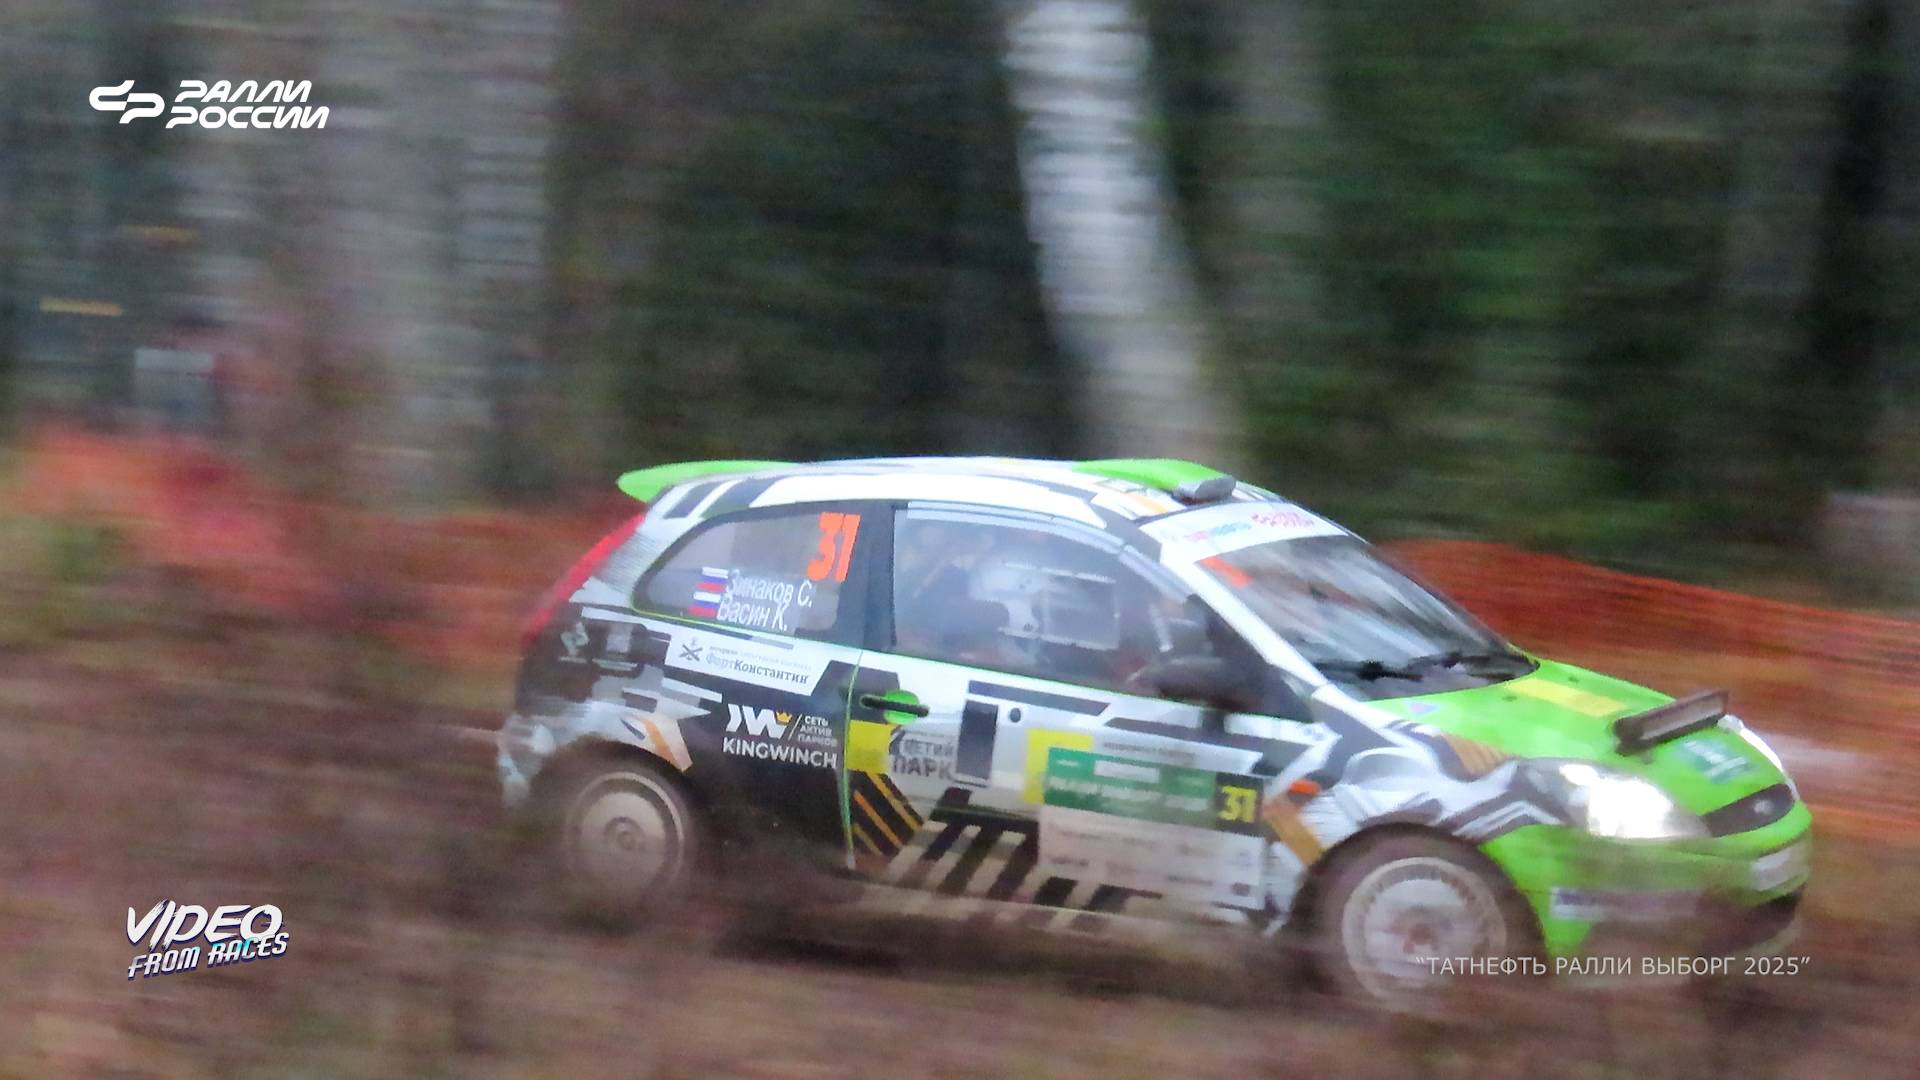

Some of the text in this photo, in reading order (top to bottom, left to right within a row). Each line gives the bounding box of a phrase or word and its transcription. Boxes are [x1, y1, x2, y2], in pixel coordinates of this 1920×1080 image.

[806, 511, 861, 582] 31
[797, 578, 813, 608] С.
[716, 595, 789, 632] Васин К.
[799, 724, 833, 737] АКТИВ
[804, 715, 829, 727] СЕТЬ
[722, 736, 838, 769] KINGWINCH
[893, 755, 954, 780] ПАРК
[1217, 785, 1257, 824] 31
